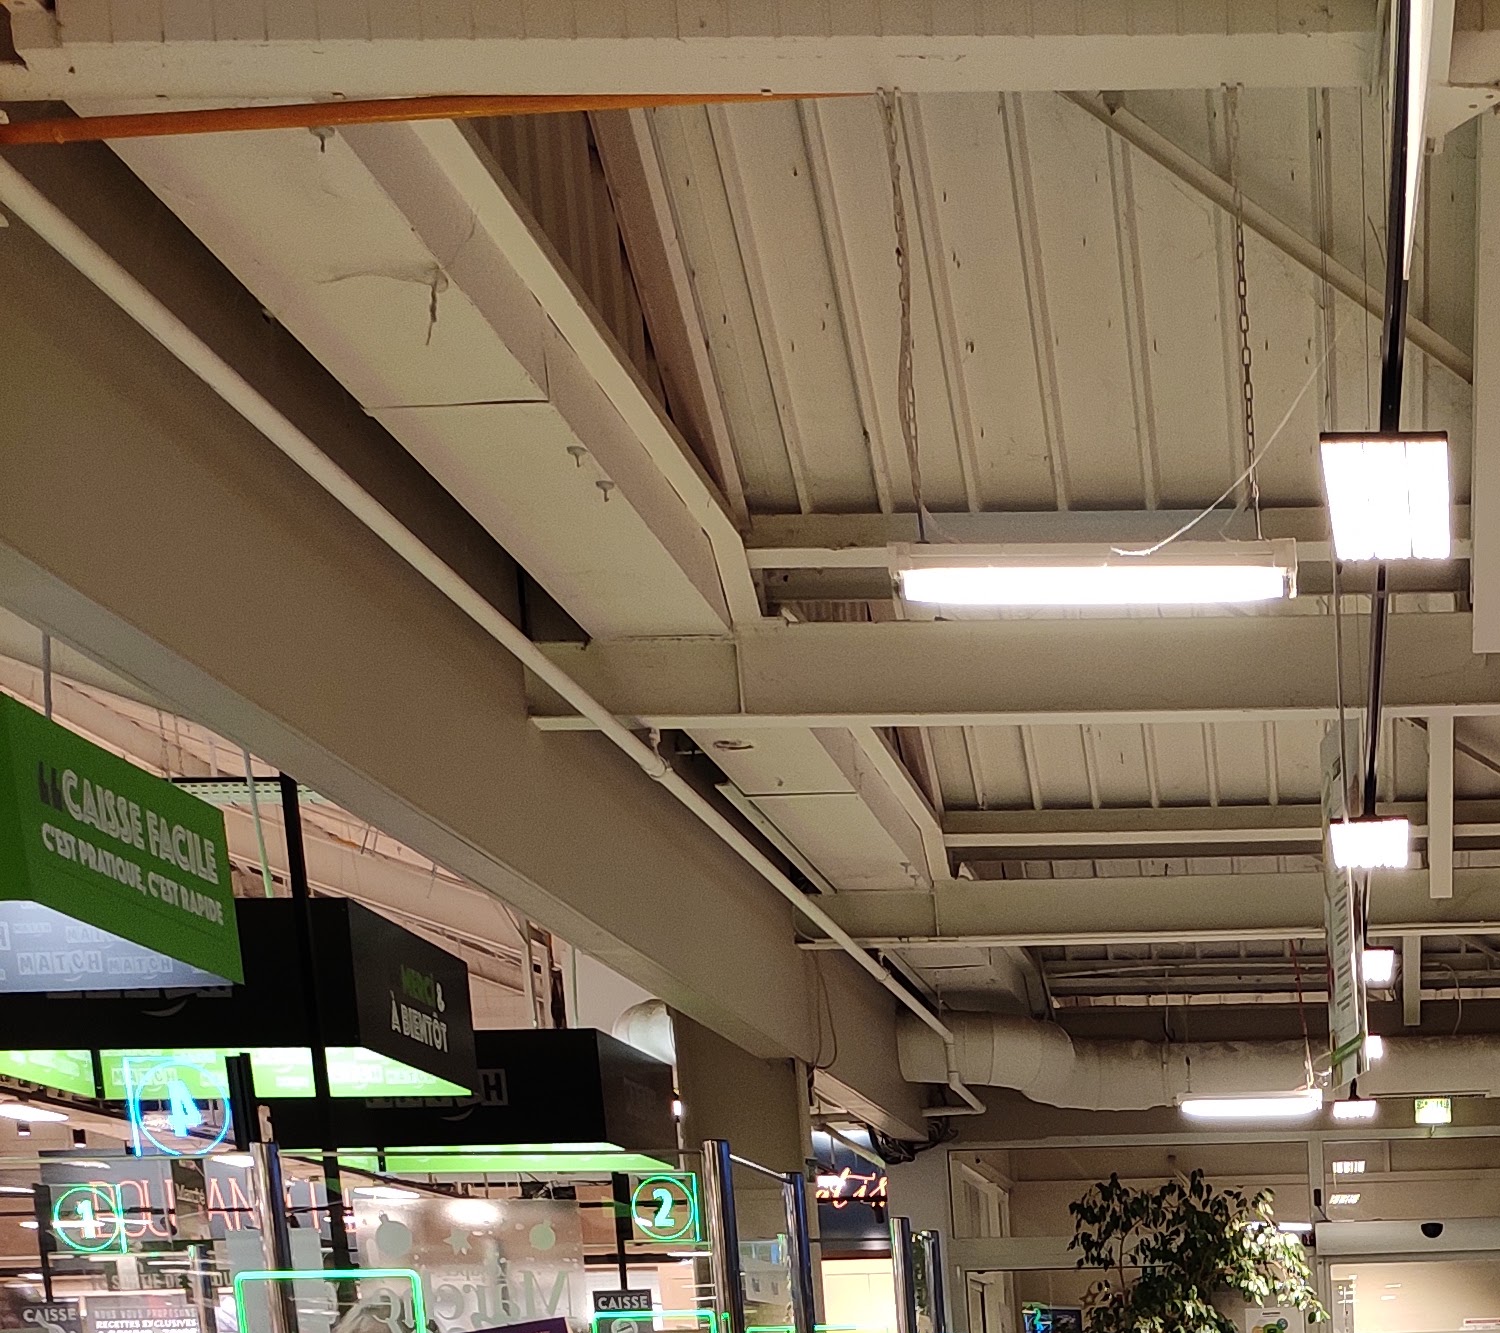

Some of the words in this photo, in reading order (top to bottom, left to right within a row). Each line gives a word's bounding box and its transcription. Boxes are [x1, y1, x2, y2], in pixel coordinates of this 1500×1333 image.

[62, 769, 145, 850] CAISSE
[146, 810, 219, 885] FACILE
[42, 823, 77, 862] C'EST
[78, 838, 147, 896] PRATIQUE,
[148, 871, 180, 906] C'EST
[180, 885, 224, 926] RAPIDE
[19, 953, 101, 973] MATCH
[435, 982, 446, 1012] &
[390, 989, 401, 1033] À
[401, 1003, 449, 1053] BIENTÔT
[75, 1200, 97, 1239] 1
[653, 1188, 675, 1227] 2
[23, 1308, 77, 1323] CAISSE
[598, 1295, 648, 1310] CAISSE
[95, 1320, 140, 1329] RECETTES
[142, 1319, 197, 1328] EXCLUSIVES
